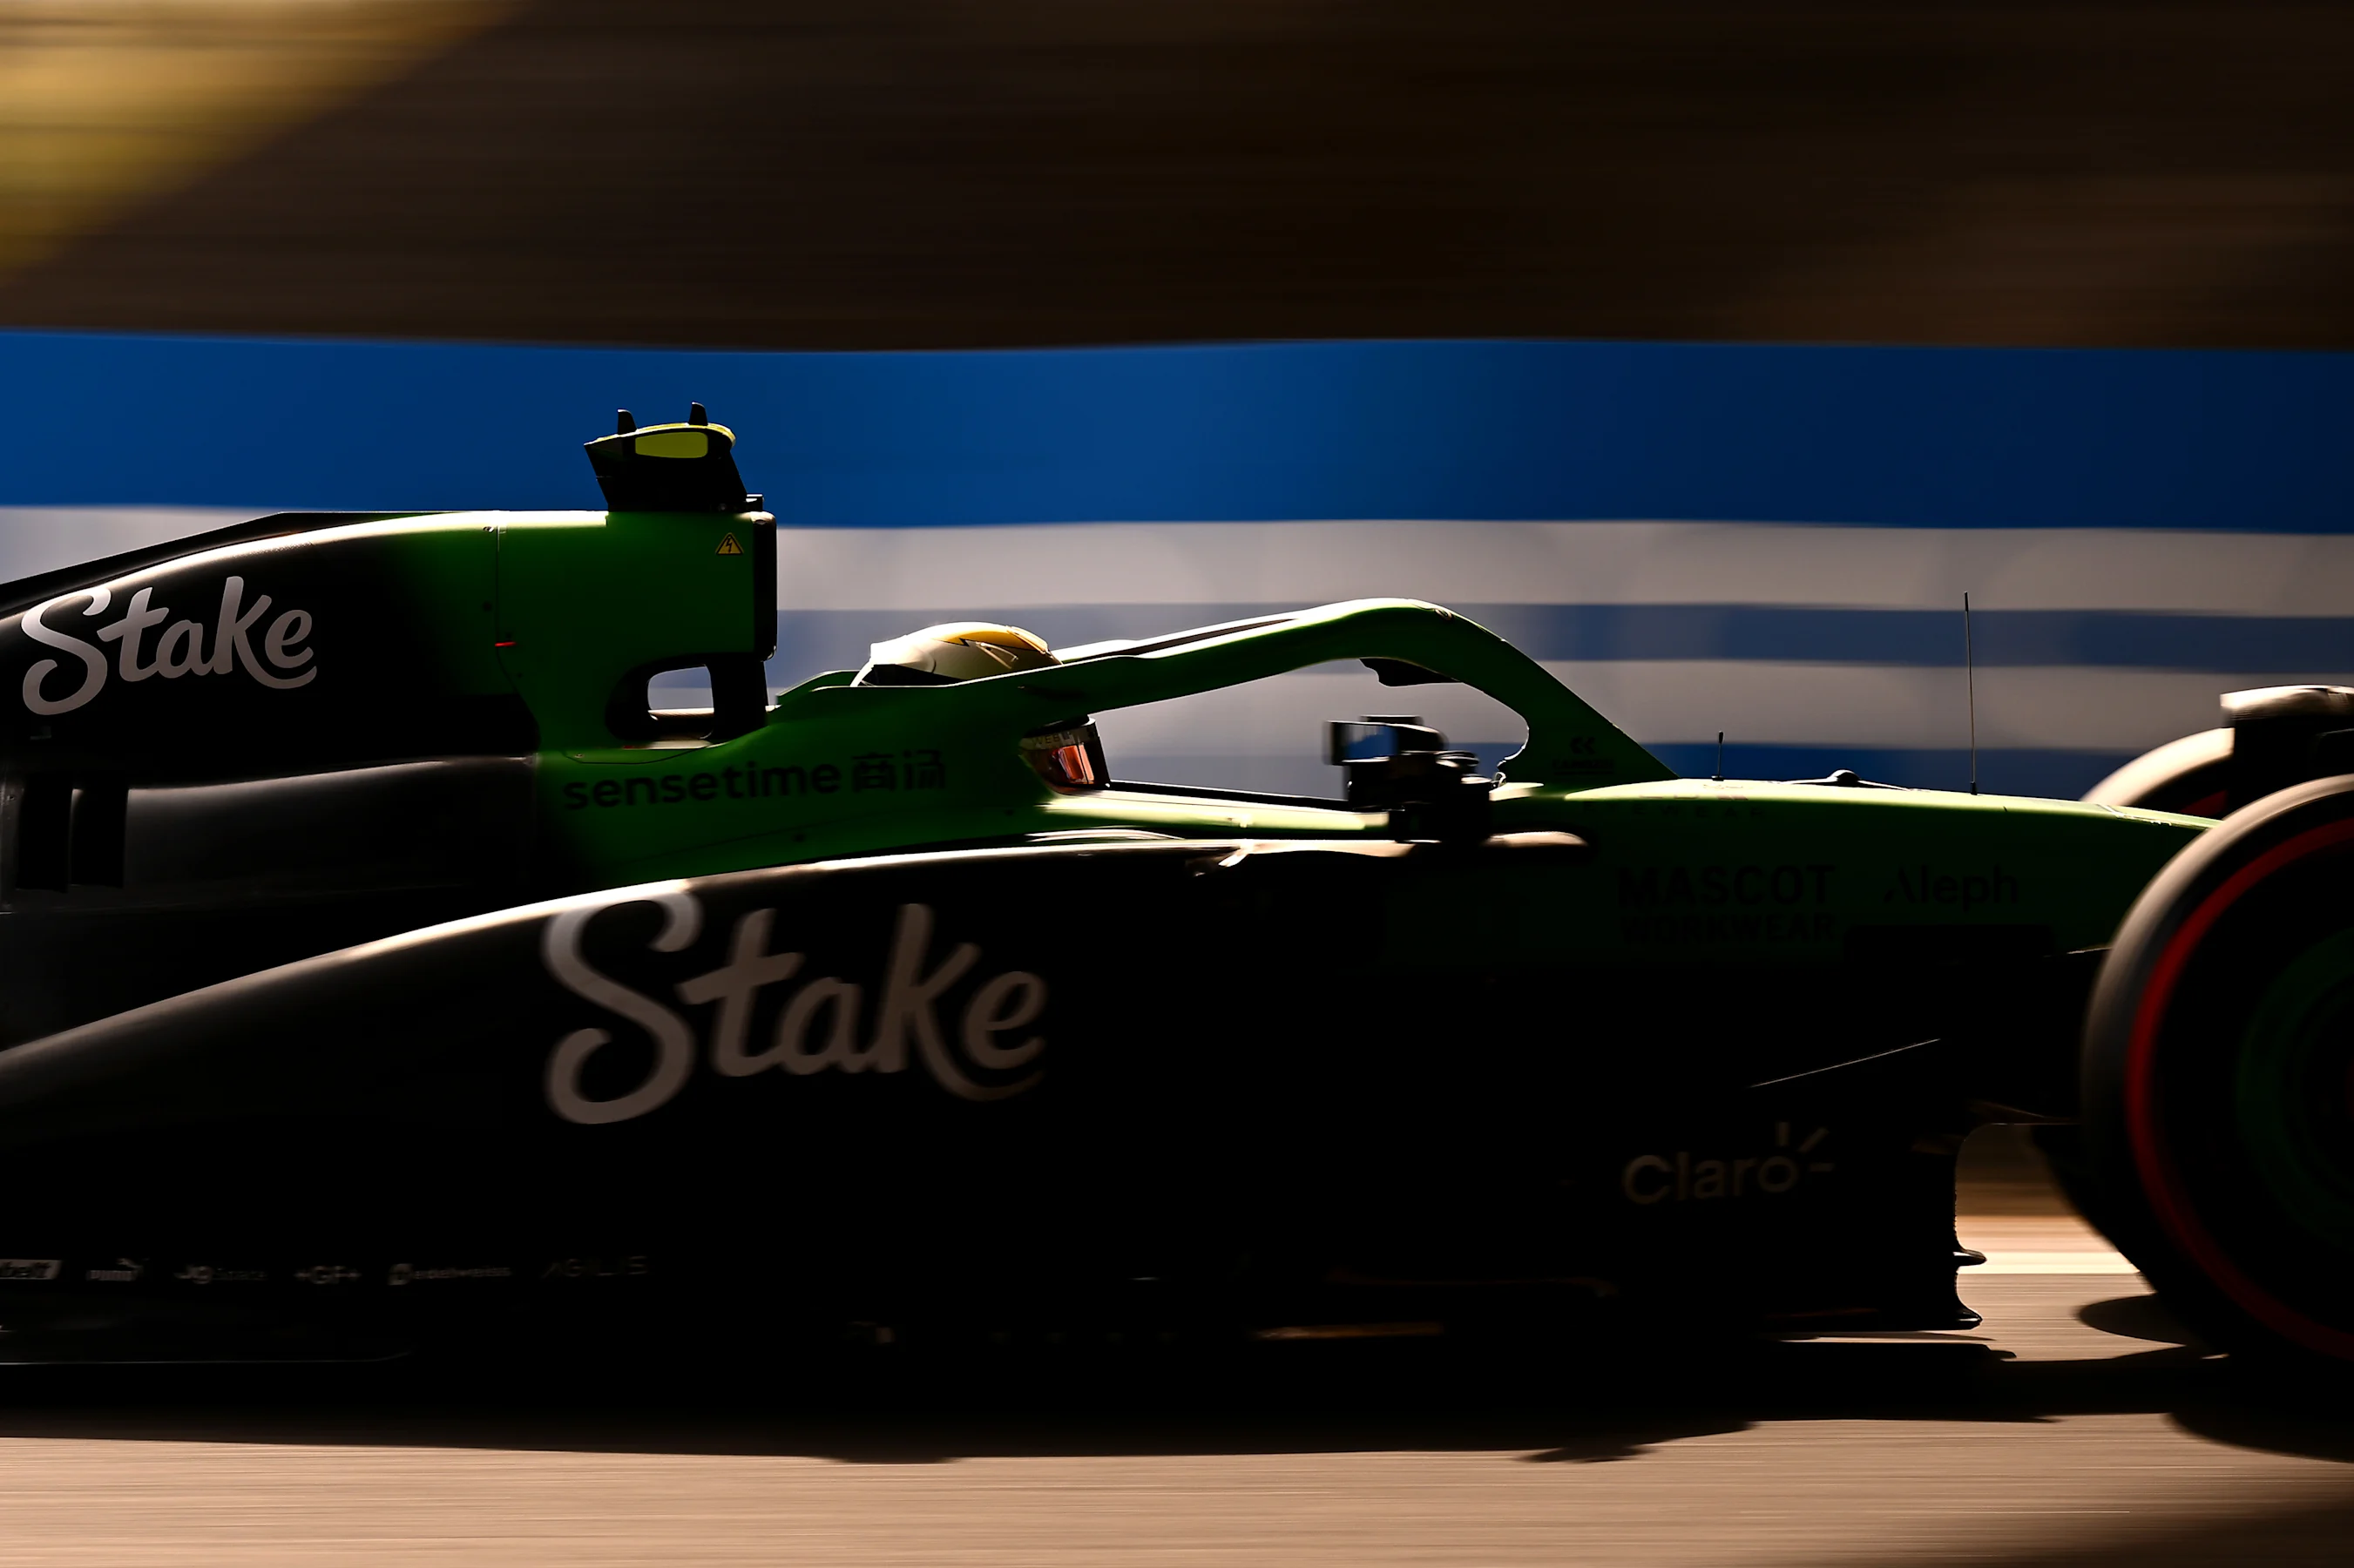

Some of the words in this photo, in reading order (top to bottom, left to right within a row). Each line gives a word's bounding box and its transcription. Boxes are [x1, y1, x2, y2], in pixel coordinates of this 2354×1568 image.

[19, 574, 318, 716] Stake
[563, 762, 842, 810] sensetime
[1617, 864, 1837, 907] MASCOT
[1883, 863, 2019, 913] Aleph
[1619, 912, 1837, 944] WORKWEAR
[538, 885, 1048, 1125] Stake
